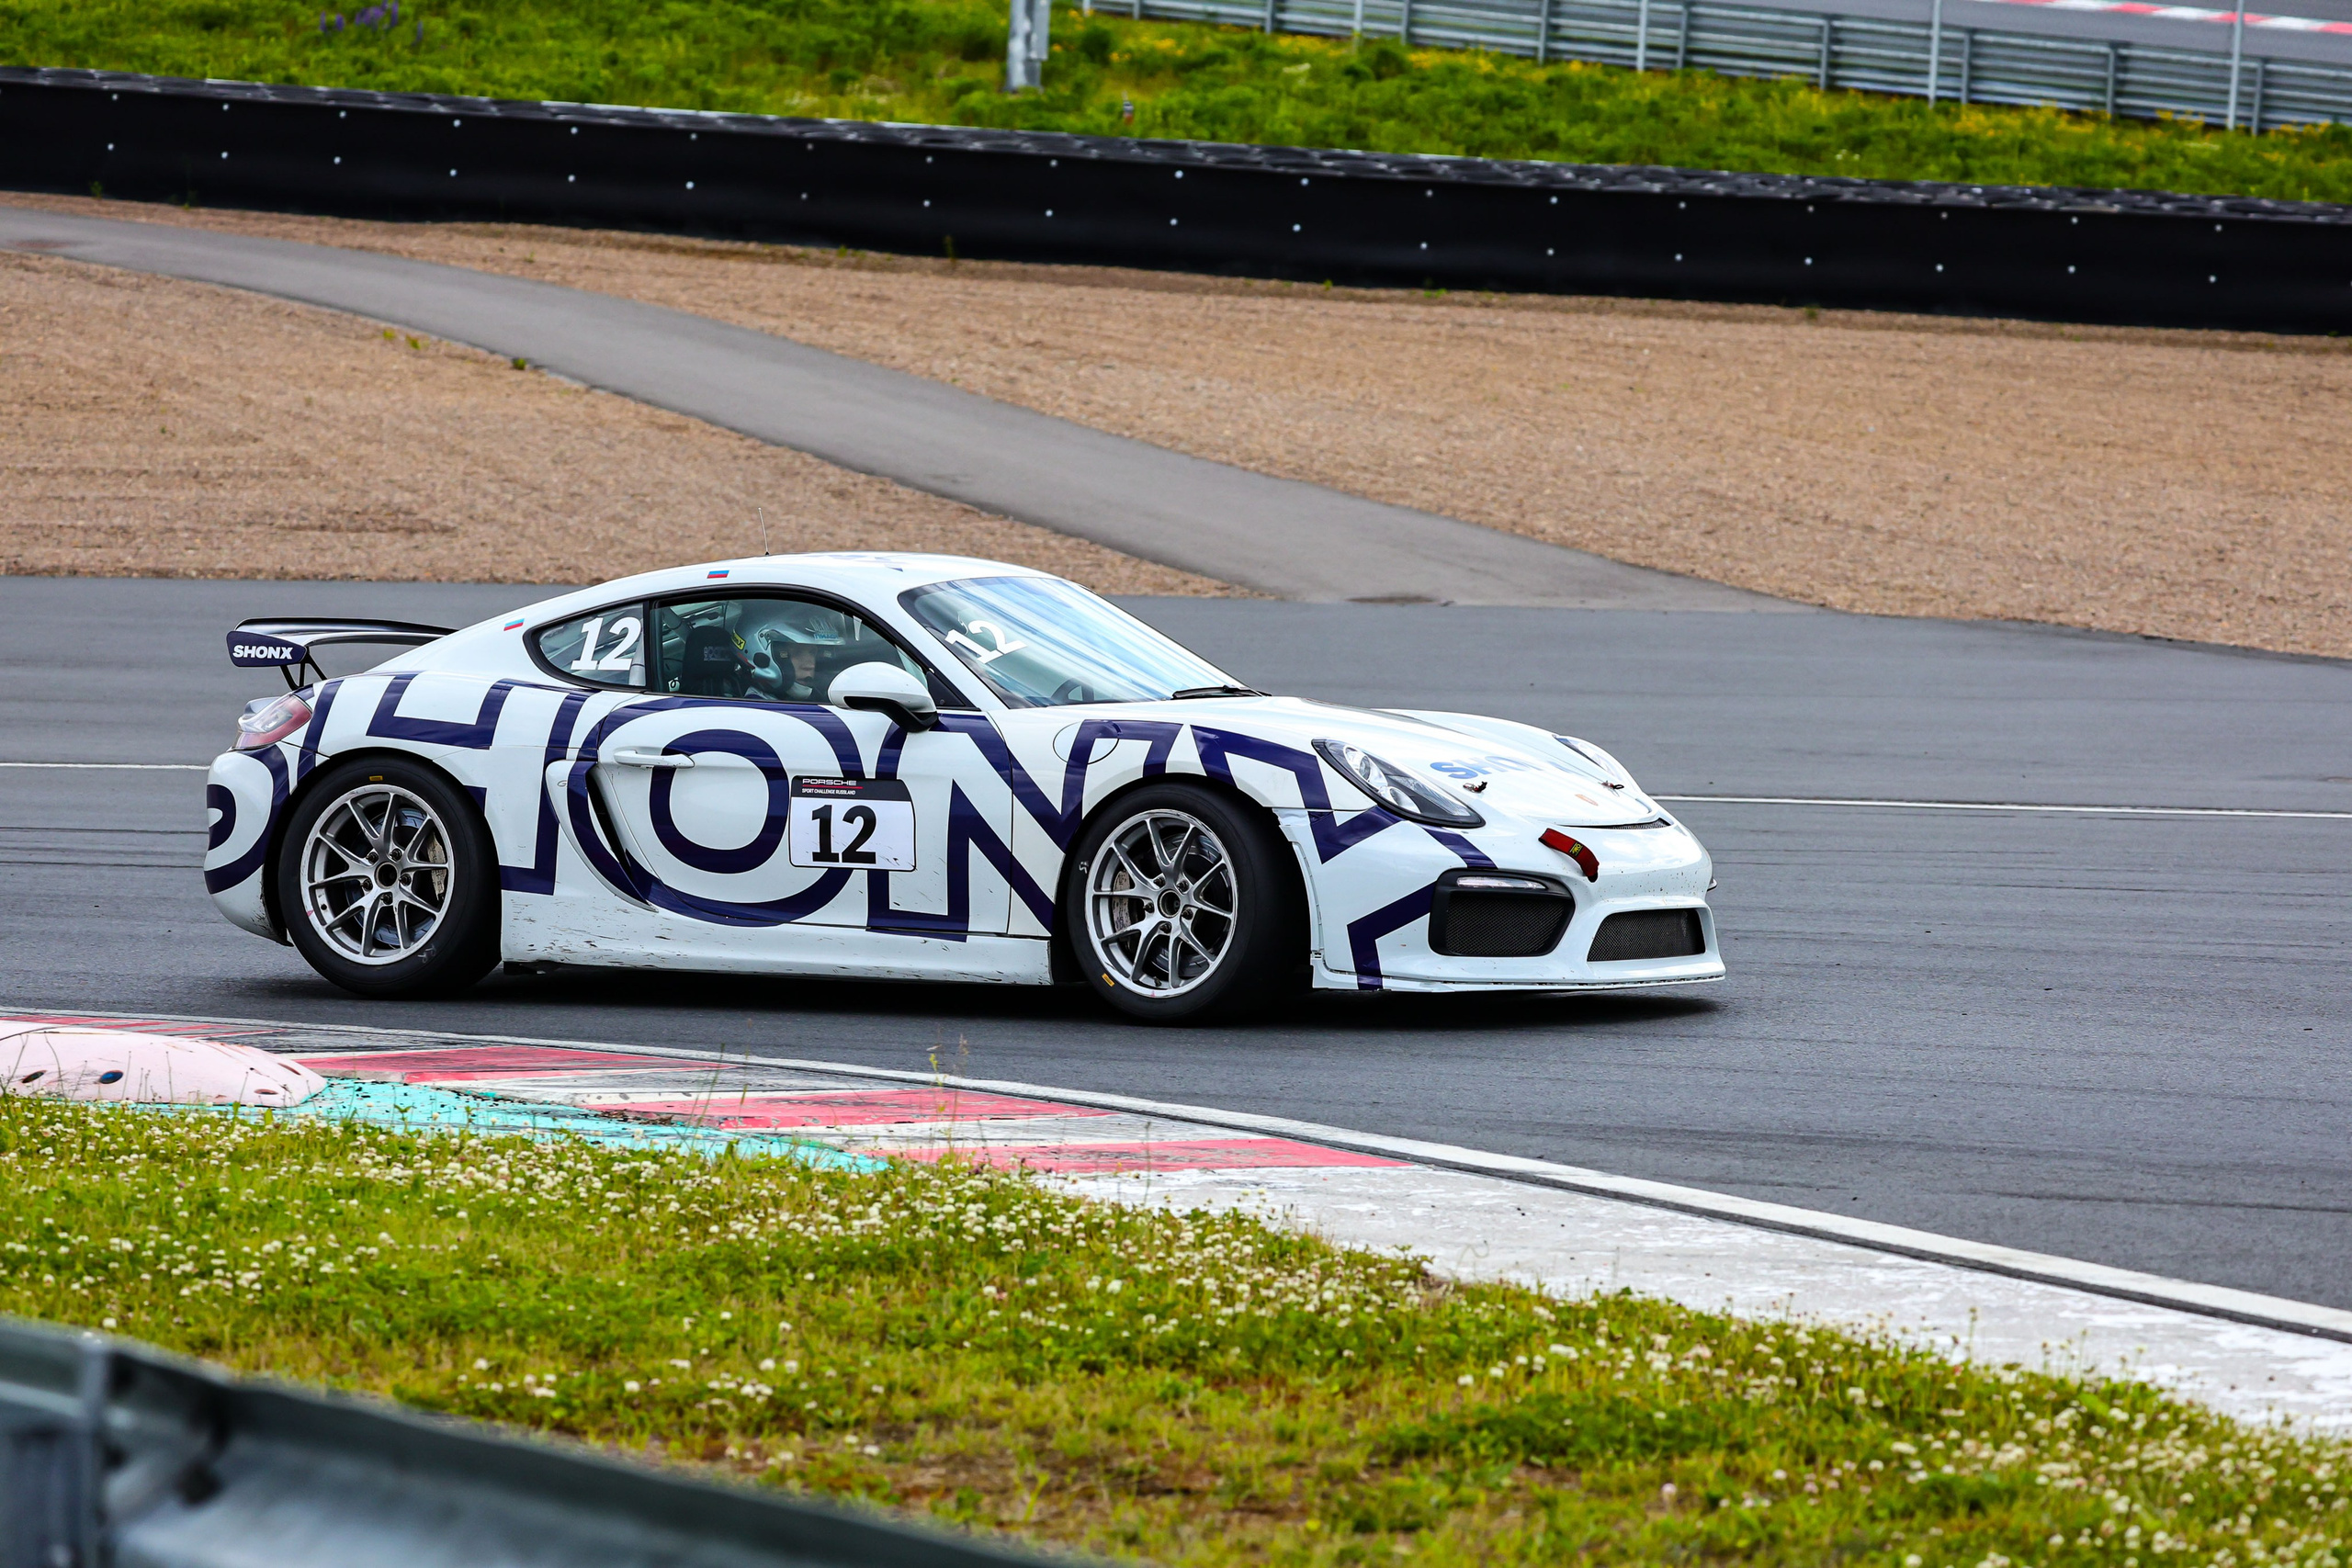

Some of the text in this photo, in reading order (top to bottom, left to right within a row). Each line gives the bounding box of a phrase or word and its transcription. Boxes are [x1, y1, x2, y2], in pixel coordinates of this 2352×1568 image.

[232, 645, 294, 660] SHONX
[571, 616, 642, 671] 12
[944, 619, 1028, 664] 12
[811, 804, 876, 864] 12
